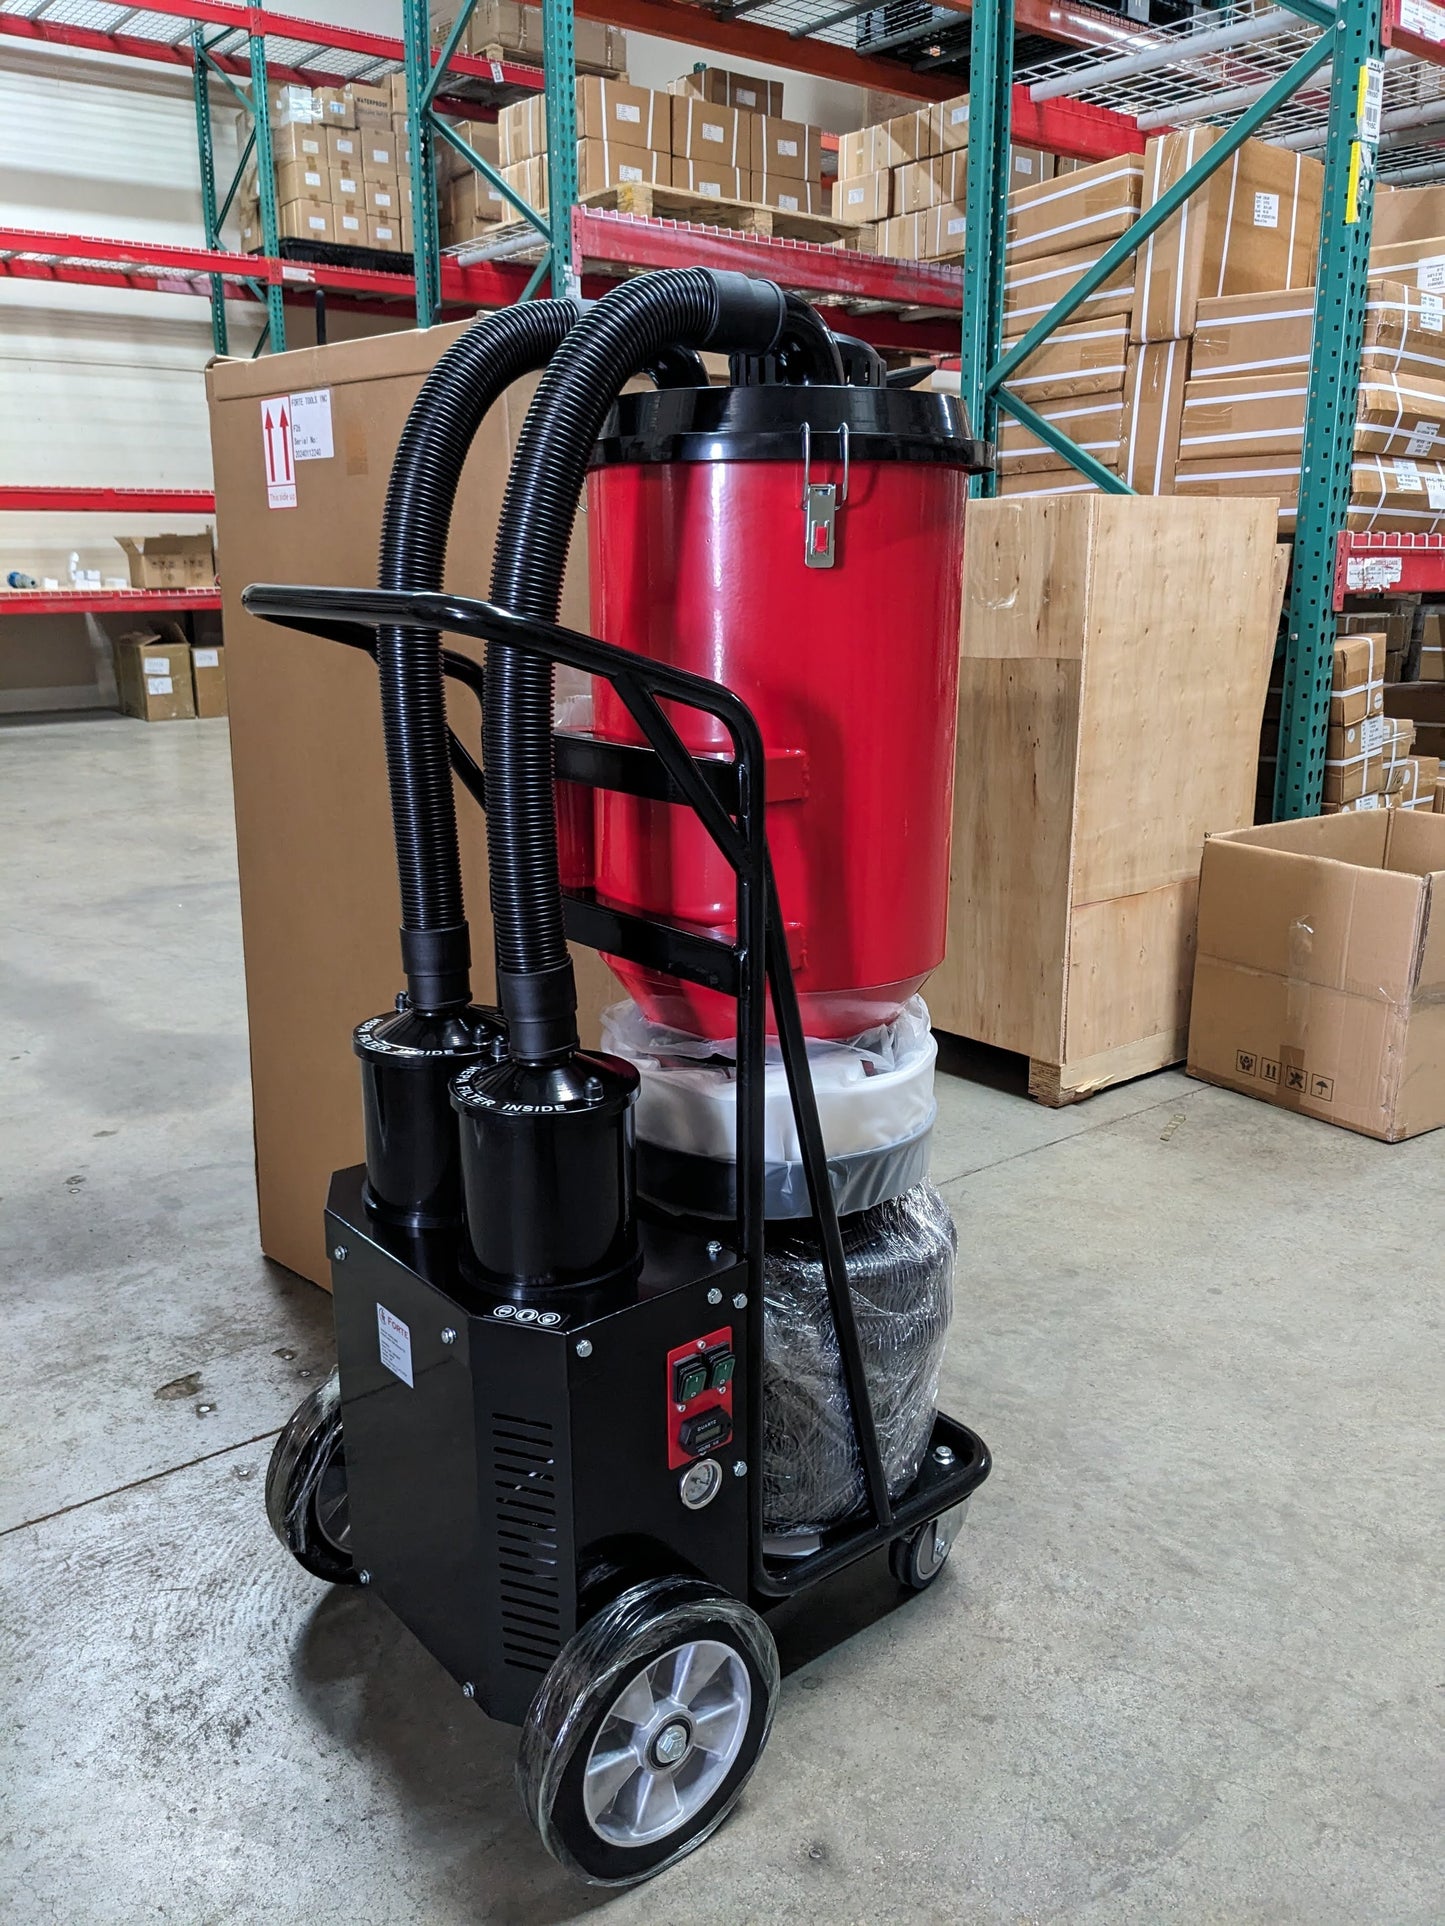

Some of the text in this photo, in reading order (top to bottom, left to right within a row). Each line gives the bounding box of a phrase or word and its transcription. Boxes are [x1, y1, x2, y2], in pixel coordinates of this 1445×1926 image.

[291, 397, 304, 407] FORTE
[304, 396, 318, 406] TOOLS
[357, 1017, 384, 1033] HEPA
[357, 1033, 392, 1052] FILTER
[455, 1065, 568, 1113] HEPA FILTER INSIDE
[387, 1317, 408, 1339] FORTE
